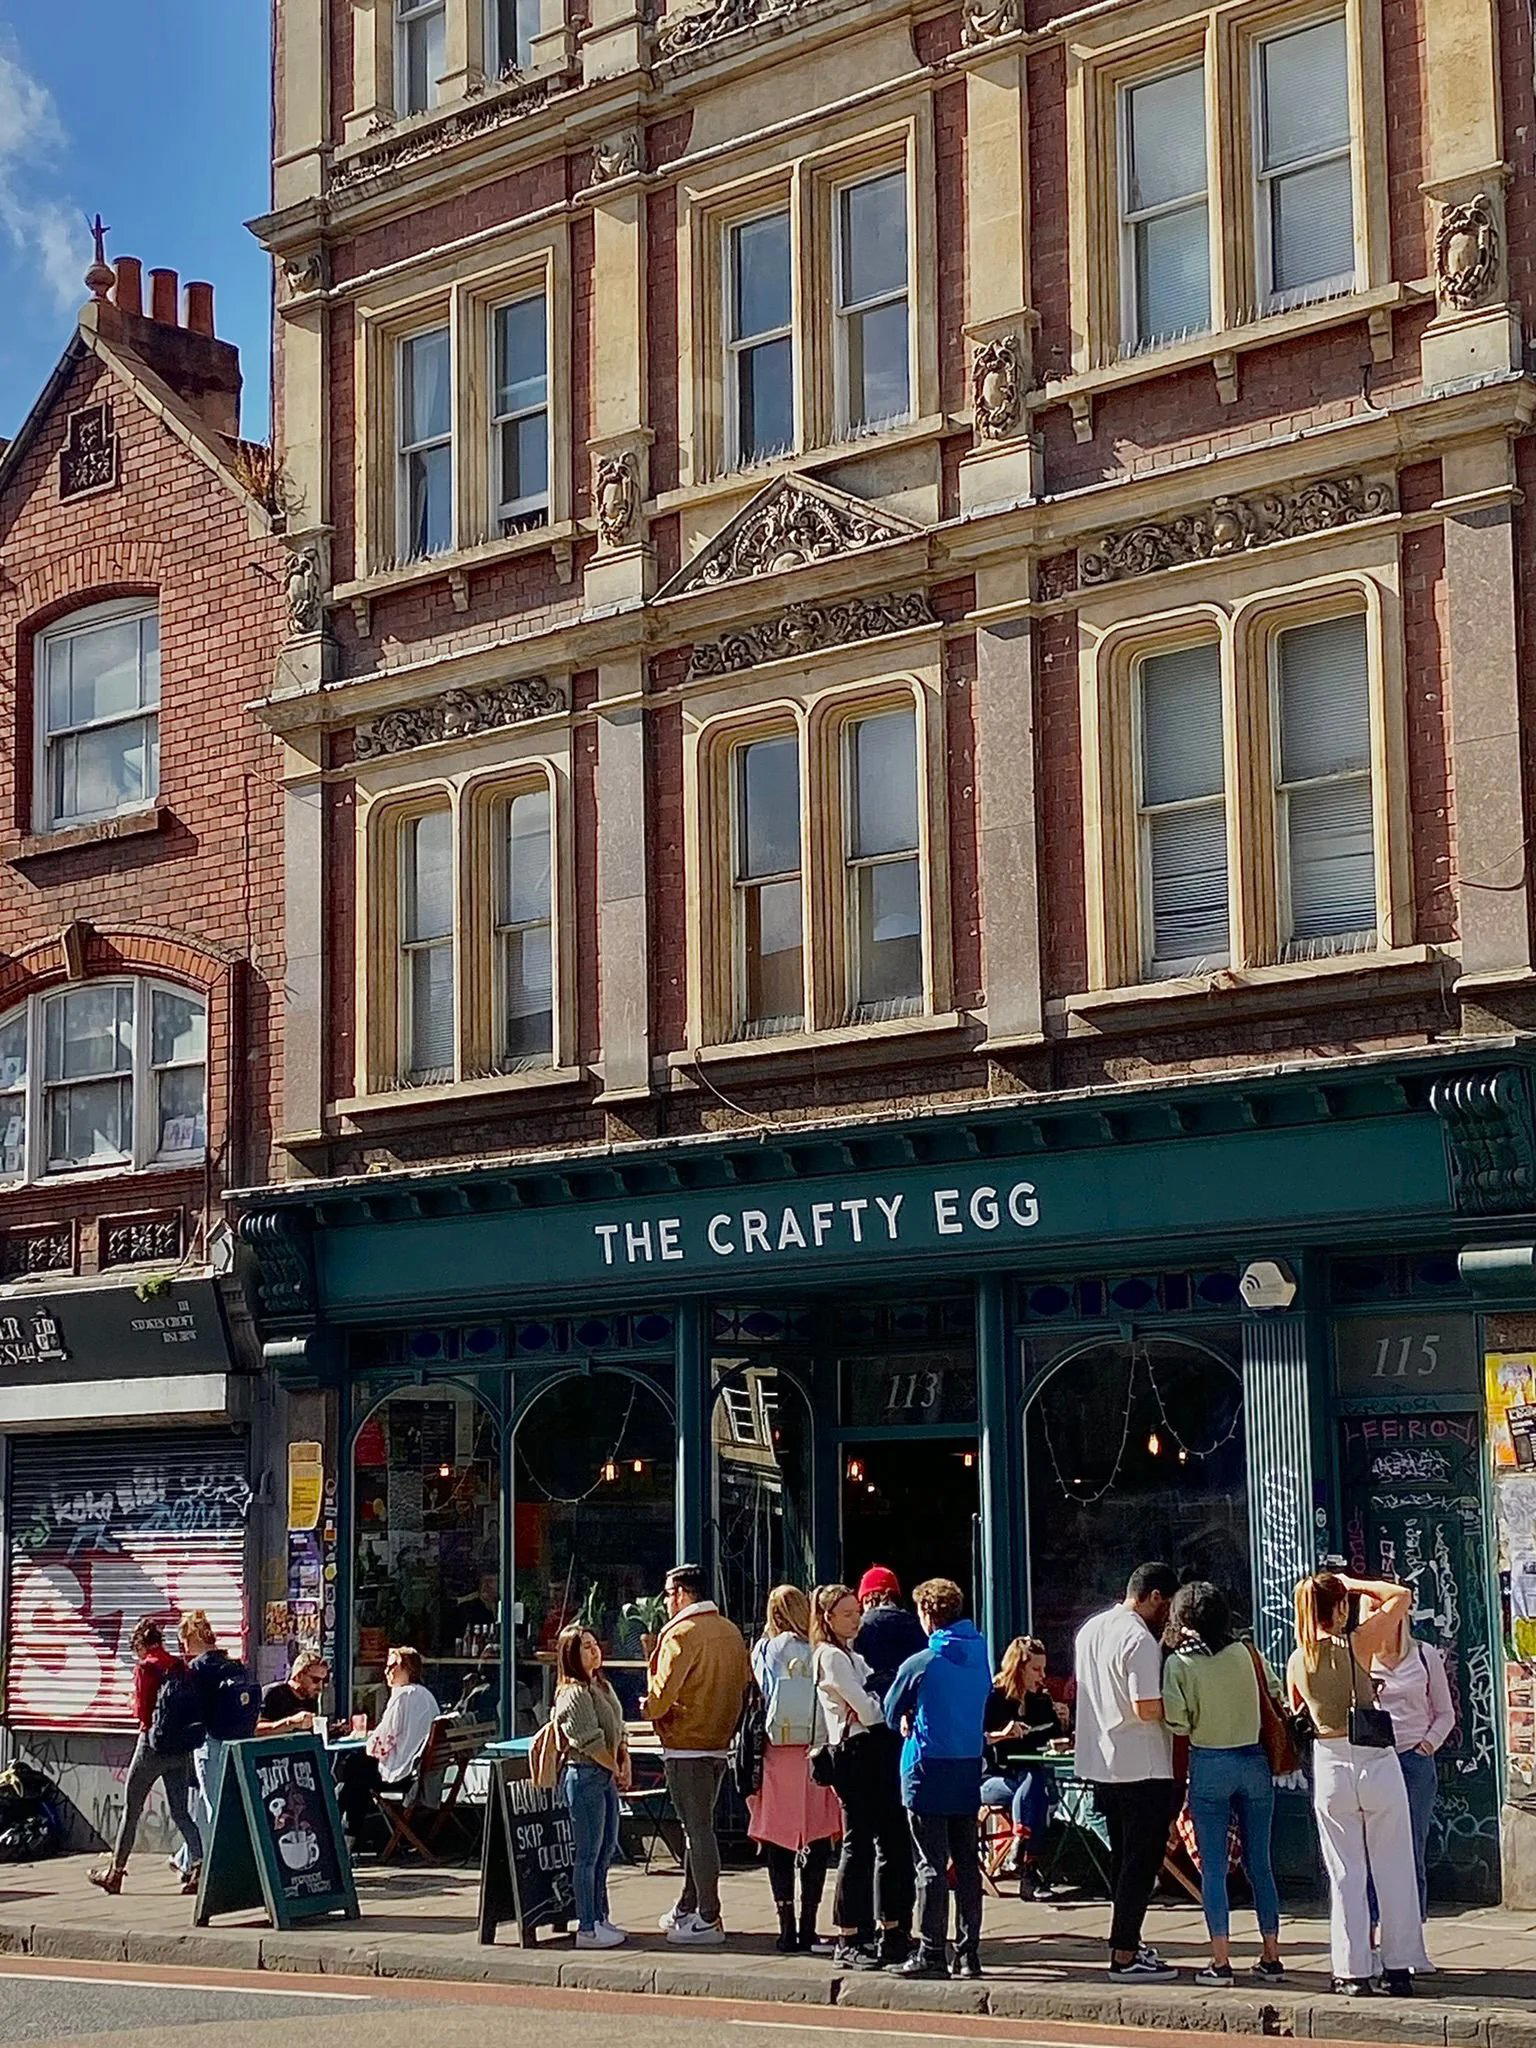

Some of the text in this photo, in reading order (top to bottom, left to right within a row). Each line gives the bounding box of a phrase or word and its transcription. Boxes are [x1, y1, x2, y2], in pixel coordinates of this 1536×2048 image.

[594, 1182, 1040, 1265] THE CRAFTY EGG
[1370, 1334, 1441, 1378] 115
[885, 1372, 939, 1409] 113
[516, 1819, 573, 1850] SKIP TH
[537, 1842, 576, 1872] QUEUE
